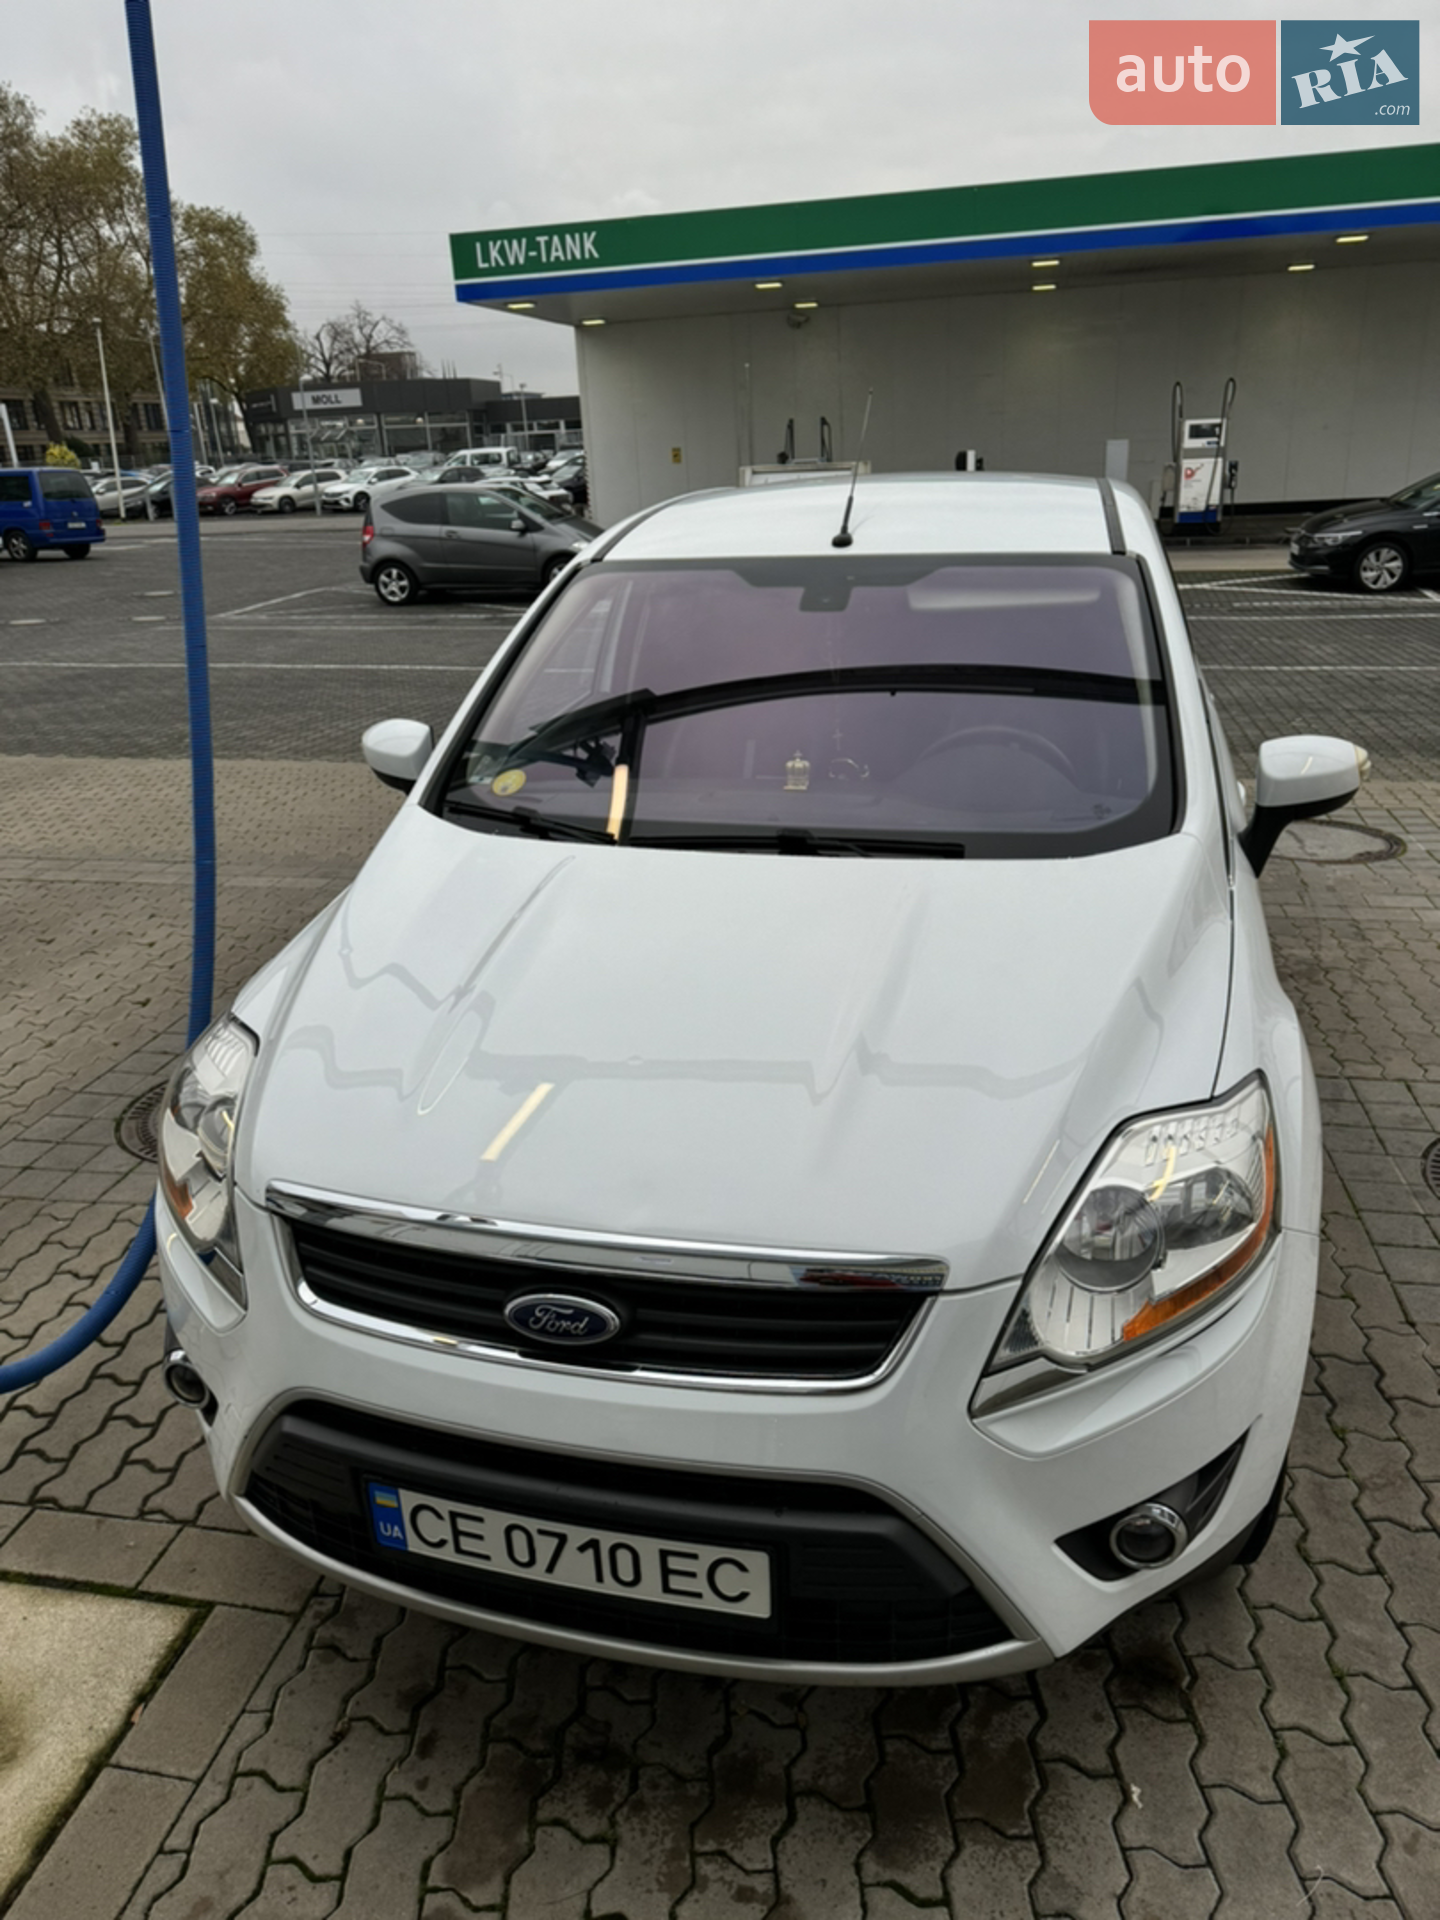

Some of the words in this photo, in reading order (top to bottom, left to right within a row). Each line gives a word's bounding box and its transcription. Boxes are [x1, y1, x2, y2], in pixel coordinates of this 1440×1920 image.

[475, 230, 600, 269] LKW-TANK
[311, 393, 342, 405] MOLL
[528, 1303, 590, 1336] Ford
[379, 1520, 404, 1541] UA
[409, 1503, 492, 1562] CE
[504, 1522, 642, 1589] 0710
[658, 1548, 751, 1604] EC
